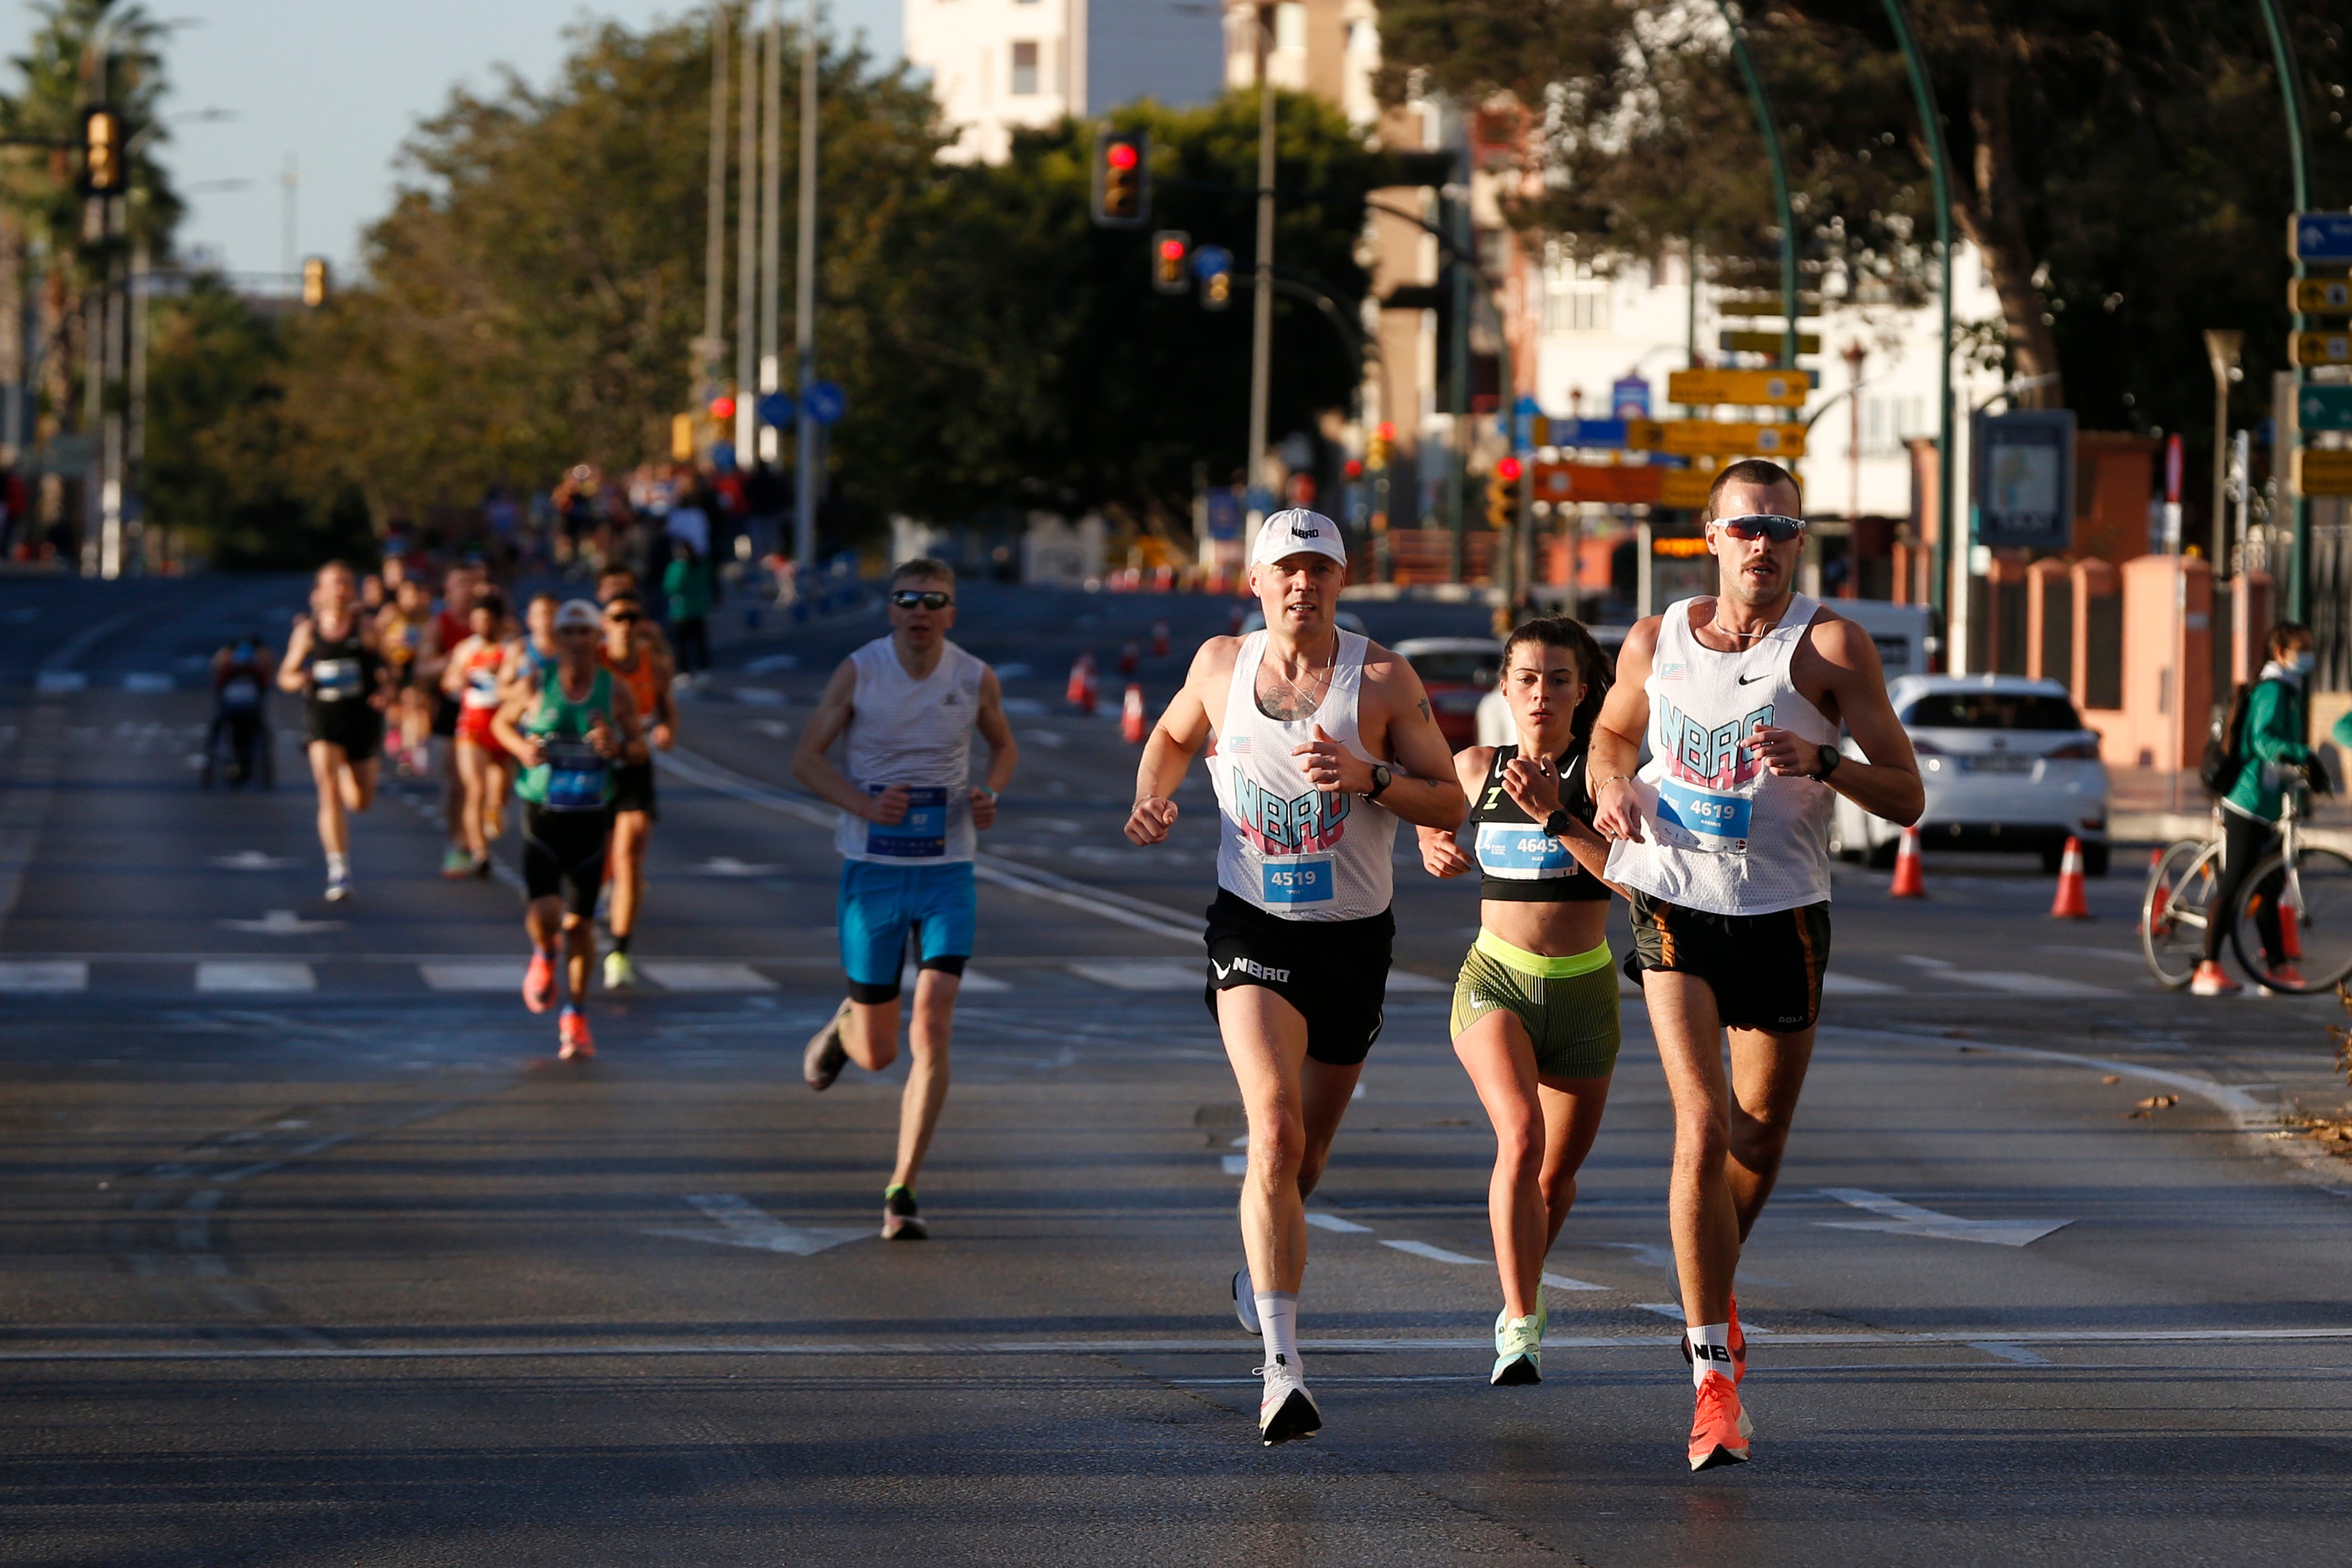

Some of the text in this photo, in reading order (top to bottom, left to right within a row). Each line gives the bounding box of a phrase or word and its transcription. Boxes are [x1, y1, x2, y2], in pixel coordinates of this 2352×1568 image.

[1291, 527, 1319, 539] NBRO
[1660, 694, 1775, 779] NBRO
[1690, 799, 1735, 820] 4619
[1701, 819, 1722, 827] RASMUS
[1517, 838, 1559, 853] 4645
[1271, 871, 1316, 886] 4519
[1232, 957, 1290, 983] NBRO
